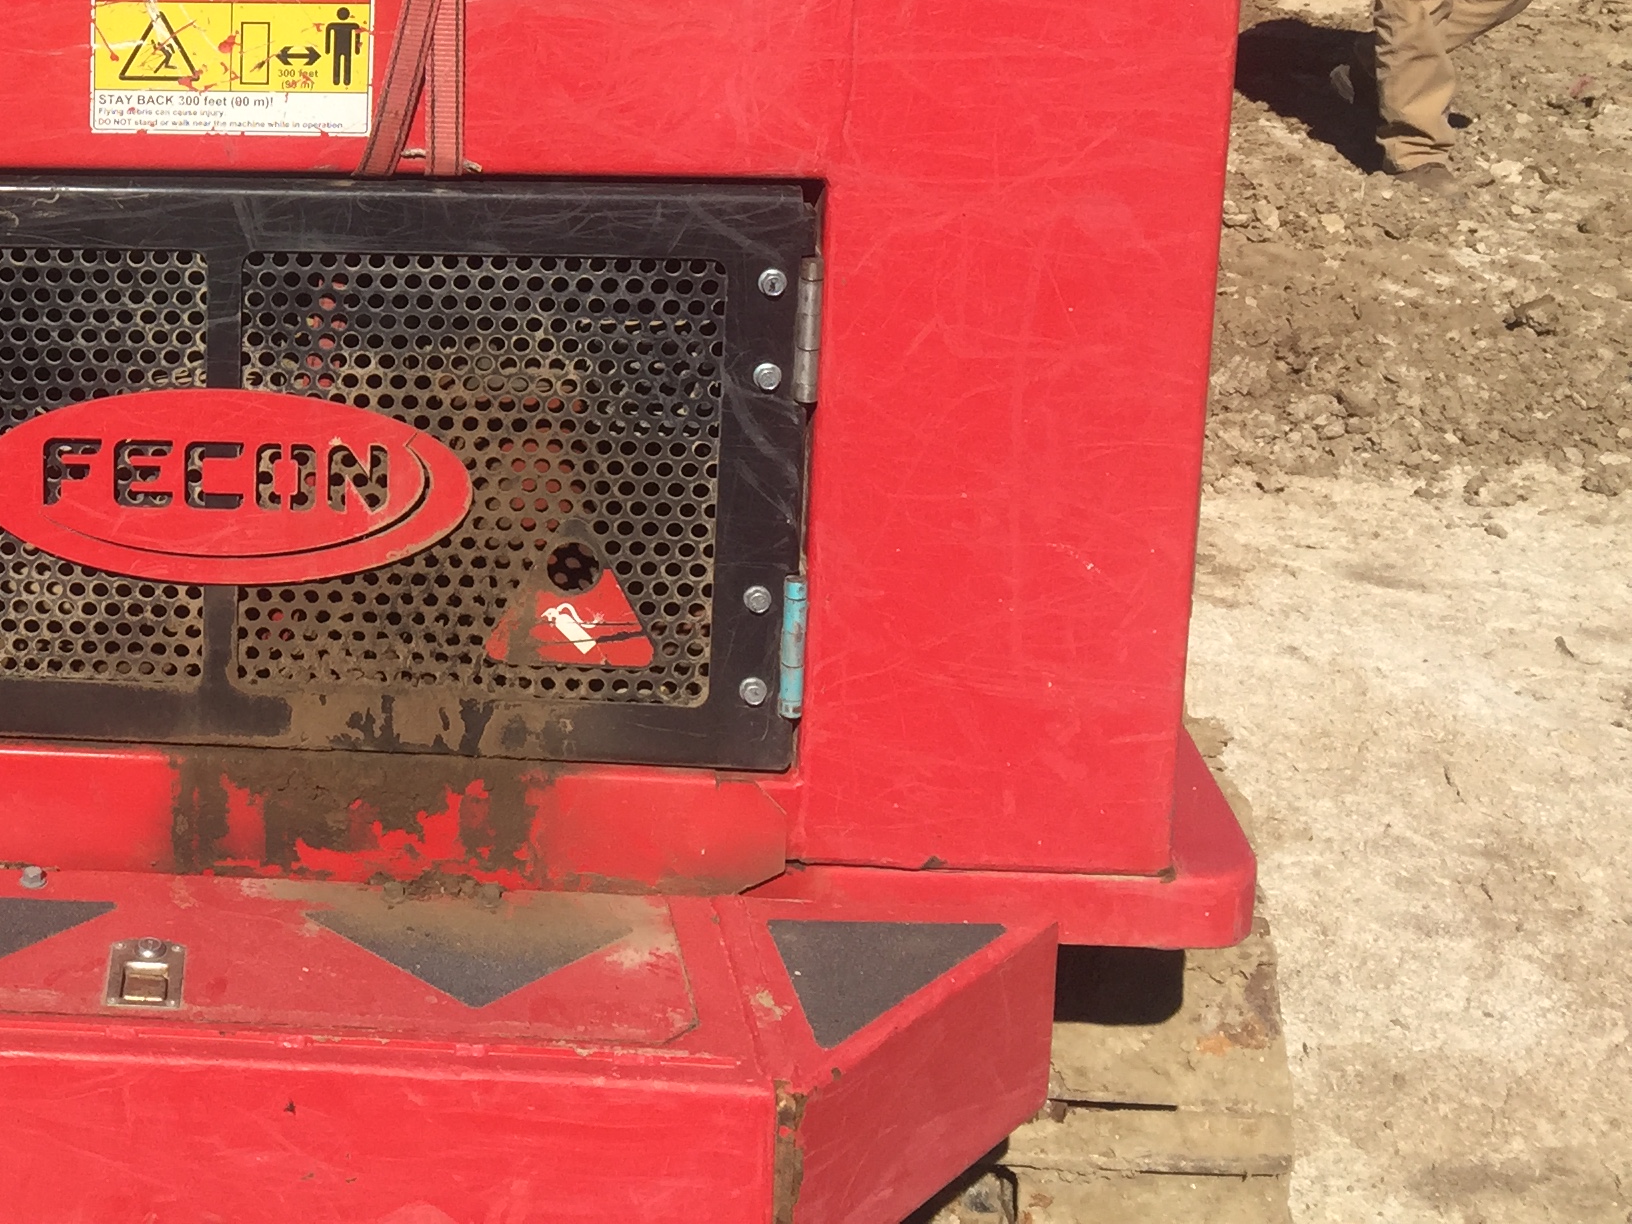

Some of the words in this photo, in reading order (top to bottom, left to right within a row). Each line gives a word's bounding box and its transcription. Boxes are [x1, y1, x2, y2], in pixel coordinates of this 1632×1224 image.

[278, 69, 295, 77] 300
[99, 94, 133, 105] STAY
[137, 95, 174, 105] BACK
[179, 95, 199, 106] 300
[204, 96, 227, 106] feet
[254, 96, 273, 109] m)!
[99, 107, 124, 116] Flying
[134, 119, 158, 127] stand
[230, 120, 265, 128] machine
[268, 120, 290, 128] while
[292, 120, 300, 128] in
[42, 436, 388, 514] FECON
